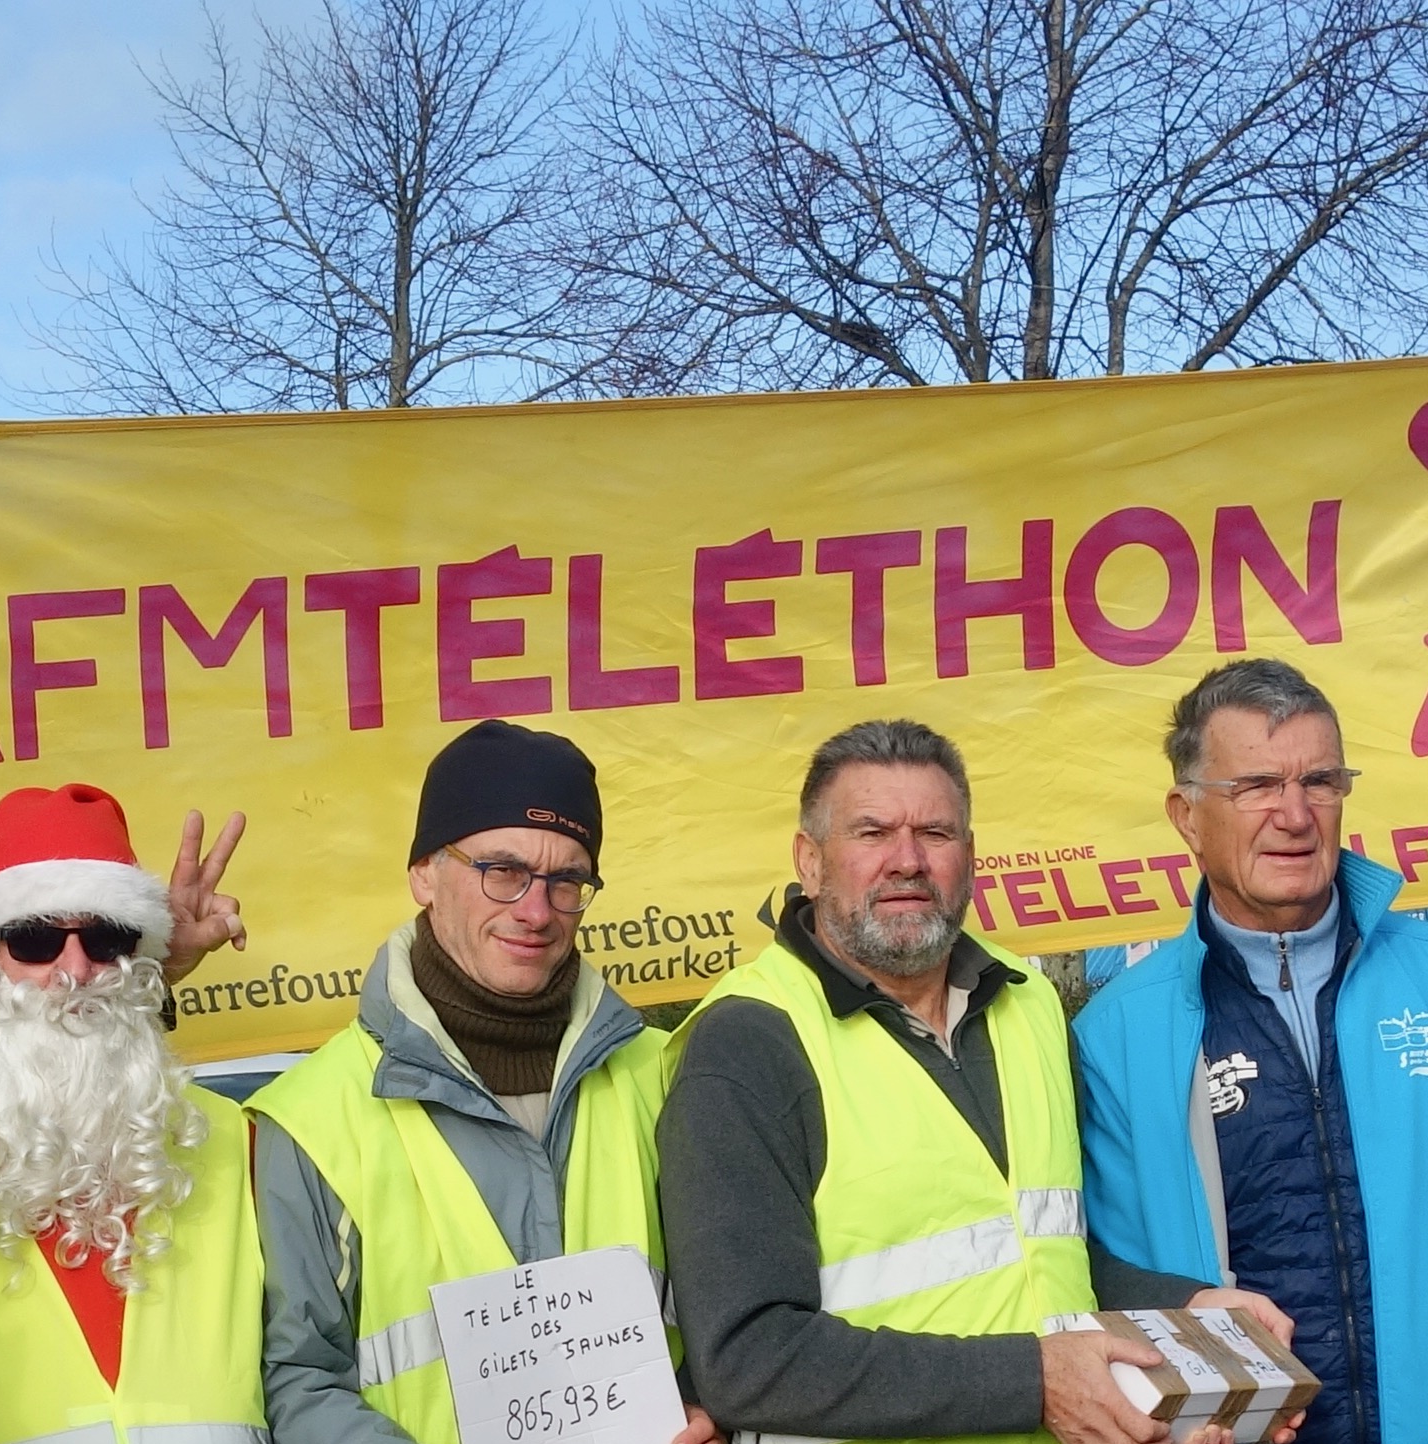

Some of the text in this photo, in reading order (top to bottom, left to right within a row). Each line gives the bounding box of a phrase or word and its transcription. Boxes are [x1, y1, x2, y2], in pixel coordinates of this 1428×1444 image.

[1016, 851, 1041, 867] EN
[1044, 845, 1097, 864] LIGNE
[602, 940, 742, 985] market
[179, 964, 363, 1016] arrefour
[514, 1269, 534, 1290] LE
[531, 1319, 562, 1339] DES
[561, 1325, 645, 1360] JAUNES
